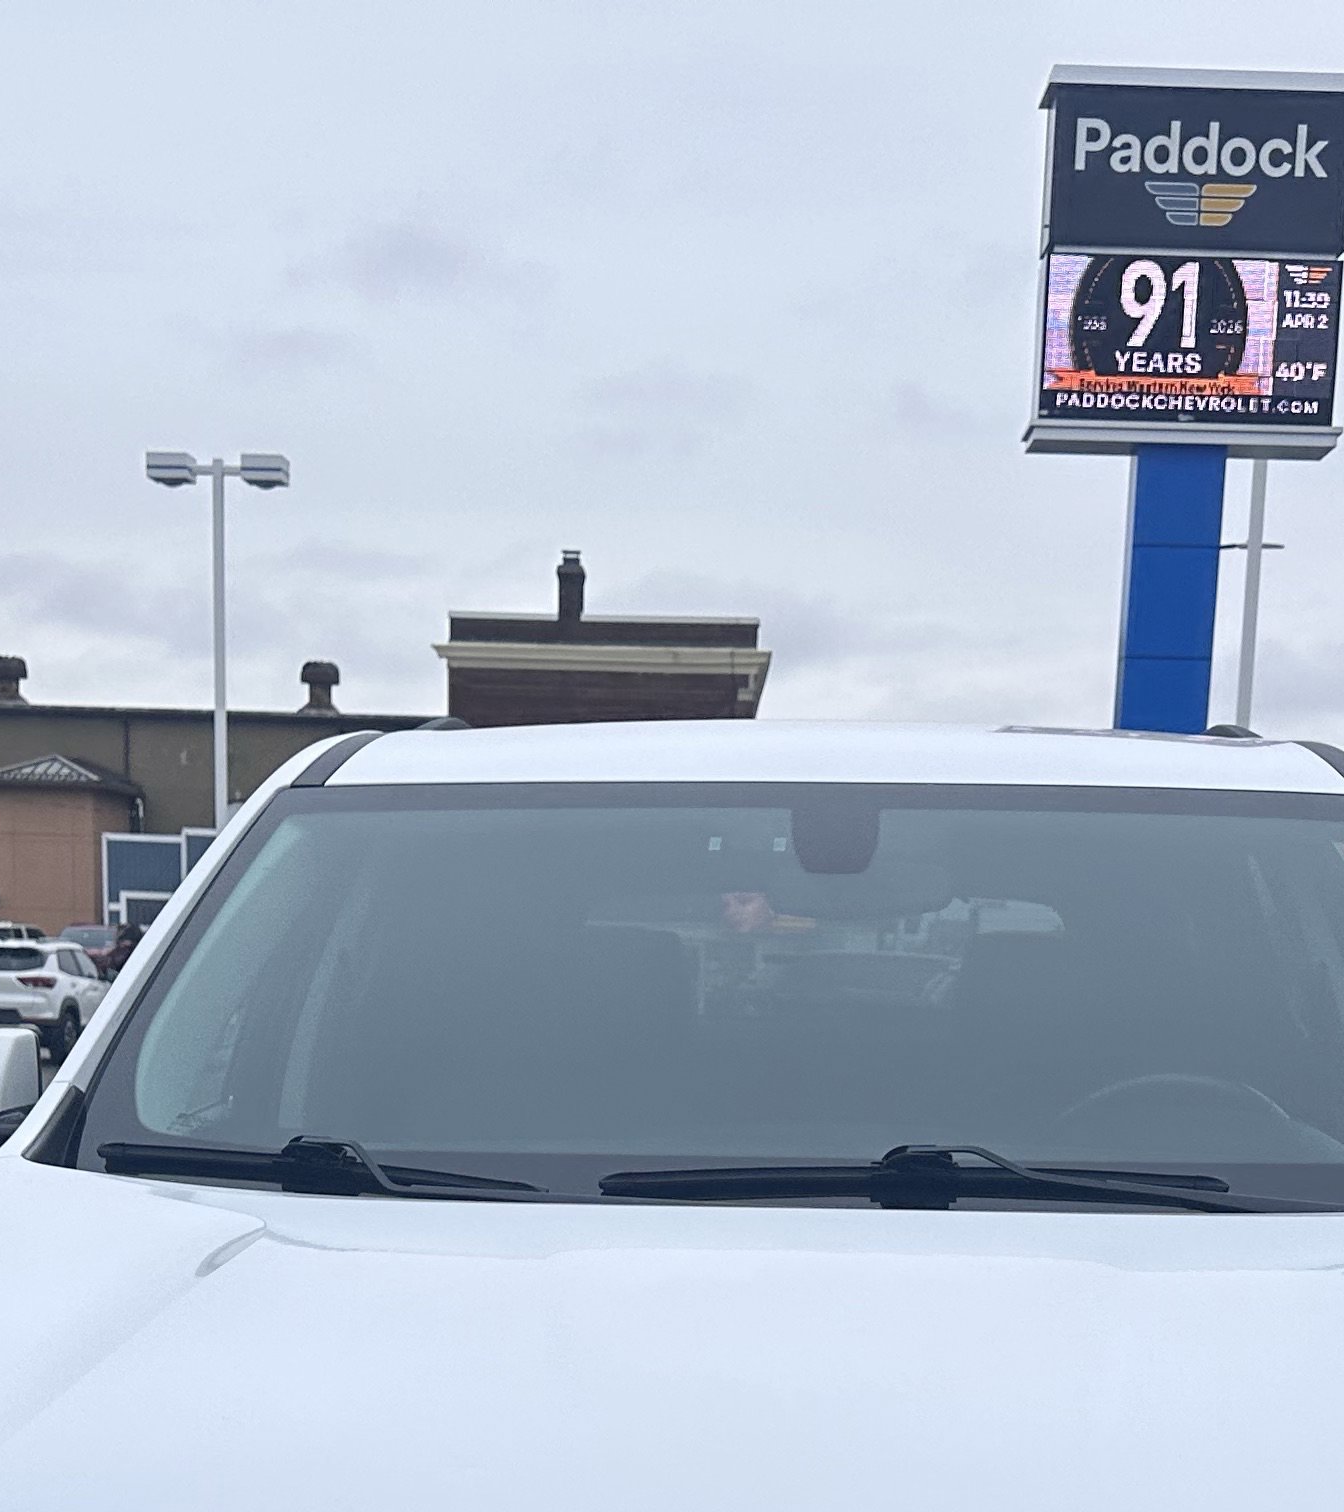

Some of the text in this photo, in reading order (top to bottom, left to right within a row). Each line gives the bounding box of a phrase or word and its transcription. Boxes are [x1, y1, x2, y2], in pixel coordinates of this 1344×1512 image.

[1074, 117, 1329, 178] Paddock
[1120, 259, 1199, 348] 91
[1281, 313, 1329, 329] APR 2
[1114, 351, 1202, 374] YEARS
